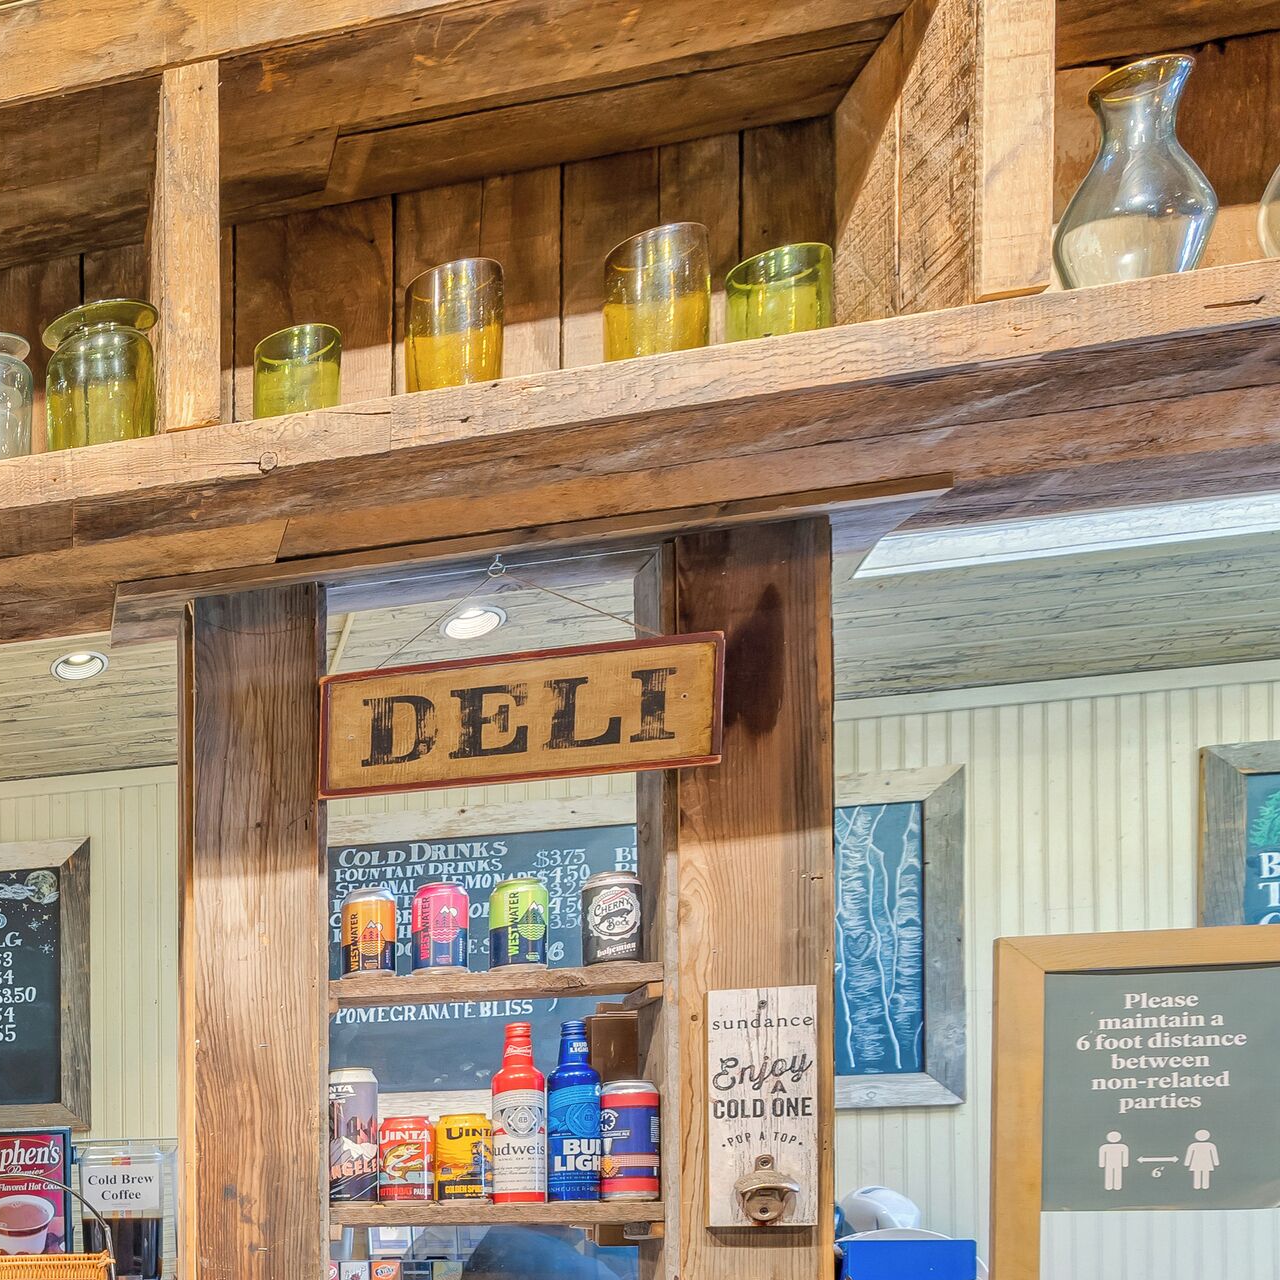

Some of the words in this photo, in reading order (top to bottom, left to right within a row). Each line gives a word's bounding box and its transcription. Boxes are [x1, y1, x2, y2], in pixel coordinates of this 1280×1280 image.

[361, 667, 677, 767] DELI
[339, 849, 406, 868] COLD
[409, 841, 509, 863] DRINKS
[334, 861, 427, 883] FOUNTAIN
[427, 858, 503, 875] DRINKS
[533, 849, 586, 868] $3.75
[594, 897, 632, 916] CHERNY
[420, 896, 430, 960] WESTWATER
[508, 891, 520, 957] WESTWATER
[597, 942, 636, 957] bohemian
[1123, 993, 1199, 1009] Please
[335, 1002, 476, 1025] POMEGRANATE
[480, 999, 534, 1018] BLISS
[1098, 1012, 1204, 1030] maintain
[1211, 1014, 1224, 1026] a
[712, 1014, 814, 1031] sundance
[1076, 1034, 1090, 1051] 6
[1095, 1034, 1142, 1050] foot
[1147, 1032, 1247, 1049] distance
[1111, 1053, 1210, 1070] between
[712, 1053, 813, 1091] Enjoy
[1091, 1071, 1231, 1090] non-related
[771, 1080, 787, 1094] A
[713, 1099, 765, 1119] COLD
[772, 1097, 812, 1117] ONE
[1119, 1093, 1202, 1114] parties
[380, 1129, 430, 1143] UINTA
[728, 1132, 752, 1146] POP
[759, 1132, 765, 1141] A
[773, 1132, 798, 1144] TOP
[28, 1182, 41, 1191] Hot
[88, 1174, 117, 1185] Cold
[122, 1174, 154, 1184] Brew
[101, 1189, 141, 1201] Coffee
